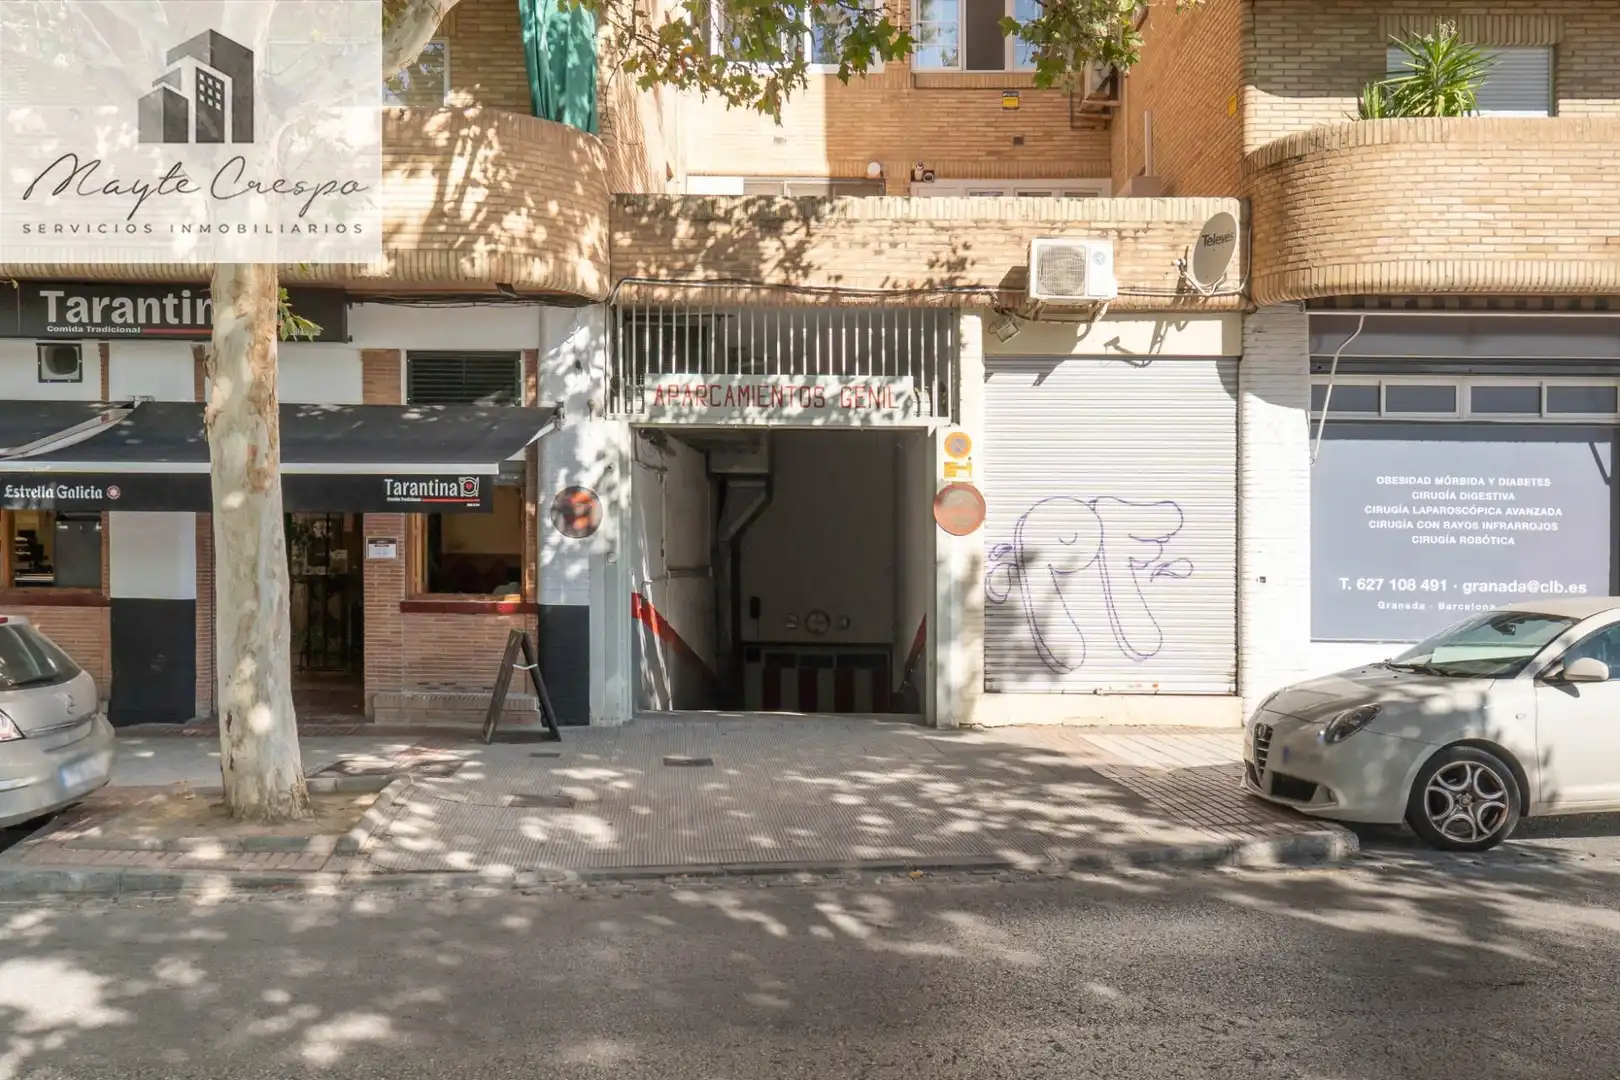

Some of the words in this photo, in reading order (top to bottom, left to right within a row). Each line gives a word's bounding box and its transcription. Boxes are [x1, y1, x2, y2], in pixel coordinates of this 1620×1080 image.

[40, 290, 212, 325] Tarantin
[47, 325, 84, 333] Comida
[87, 325, 141, 334] Tradicional
[653, 384, 826, 409] APARCAMIENTOS
[840, 386, 898, 409] GENIL
[385, 478, 458, 496] Tarantina
[1376, 475, 1432, 486] OBESIDAD
[1434, 474, 1486, 486] MÓRBIDA
[1488, 477, 1496, 486] Y
[1498, 477, 1552, 487] DIABETES
[4, 484, 55, 499] Estrella
[56, 485, 103, 499] Galicia
[1411, 488, 1457, 501] CIRUGÍA
[1459, 491, 1516, 501] DIGESTIVA
[1364, 503, 1410, 515] CIRUGÍA
[1412, 504, 1503, 516] LAPAROSCÓPICA
[1504, 507, 1563, 517] AVANZADA
[1368, 518, 1414, 530] CIRUGÍA
[1416, 520, 1440, 530] CON
[1443, 520, 1480, 531] RAYOS
[1482, 521, 1559, 532] INFRARROJOS
[1411, 533, 1457, 545] CIRUGÍA
[1459, 533, 1516, 546] ROBÓTICA
[1339, 577, 1352, 591] T.
[1356, 577, 1385, 591] 627
[1389, 578, 1417, 592] 108
[1420, 578, 1447, 592] 491
[1377, 600, 1427, 610] Granada
[1437, 601, 1497, 612] Barcelona
